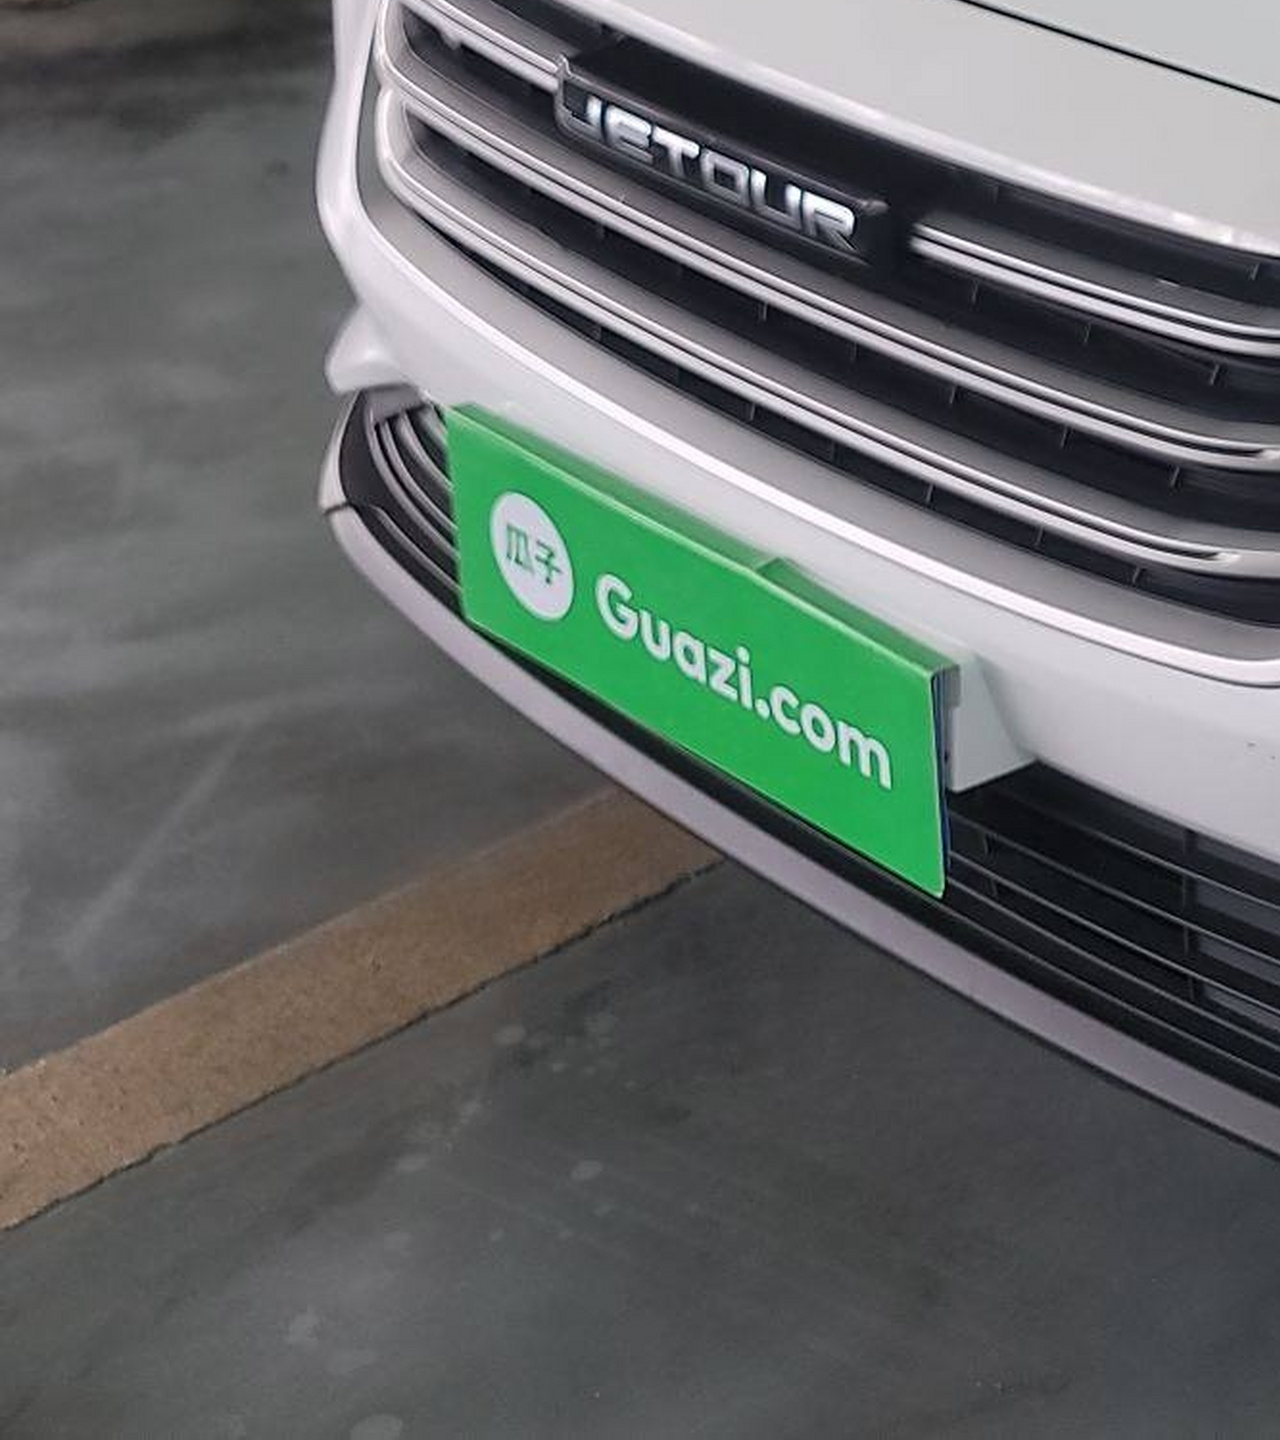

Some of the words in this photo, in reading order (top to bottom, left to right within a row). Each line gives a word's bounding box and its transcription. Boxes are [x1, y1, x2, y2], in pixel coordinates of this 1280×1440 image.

[562, 93, 857, 251] JETOUR
[505, 522, 563, 585] 瓜子
[595, 573, 893, 790] Guazi.com
